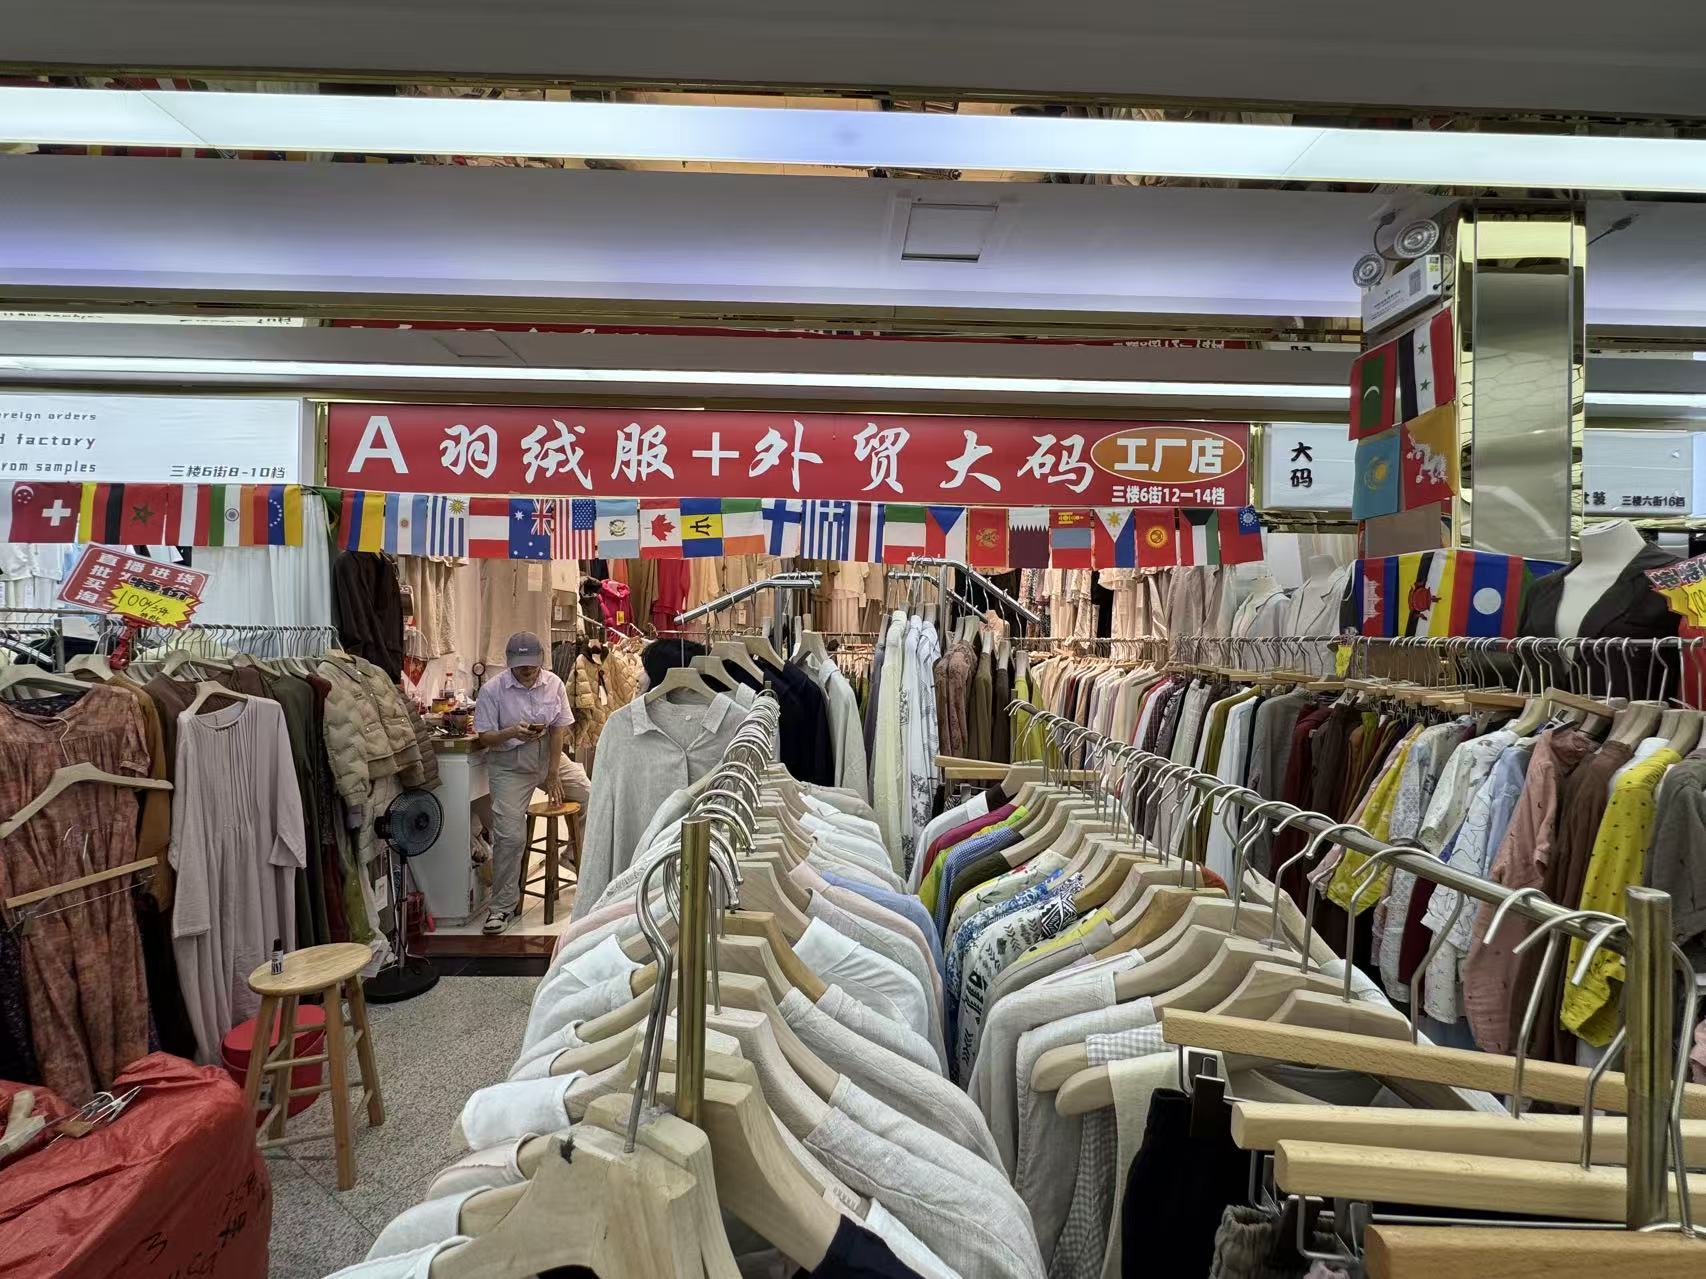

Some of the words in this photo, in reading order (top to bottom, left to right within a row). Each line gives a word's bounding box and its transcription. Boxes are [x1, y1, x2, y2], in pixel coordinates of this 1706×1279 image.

[0, 411, 41, 421] reign
[48, 411, 97, 421] orders
[17, 433, 96, 450] factory
[1114, 437, 1224, 474] 工厂店
[36, 460, 96, 475] samples
[169, 465, 286, 479] 三楼6街8-10档
[1290, 441, 1313, 489] 大码
[96, 552, 197, 585] 直播进货
